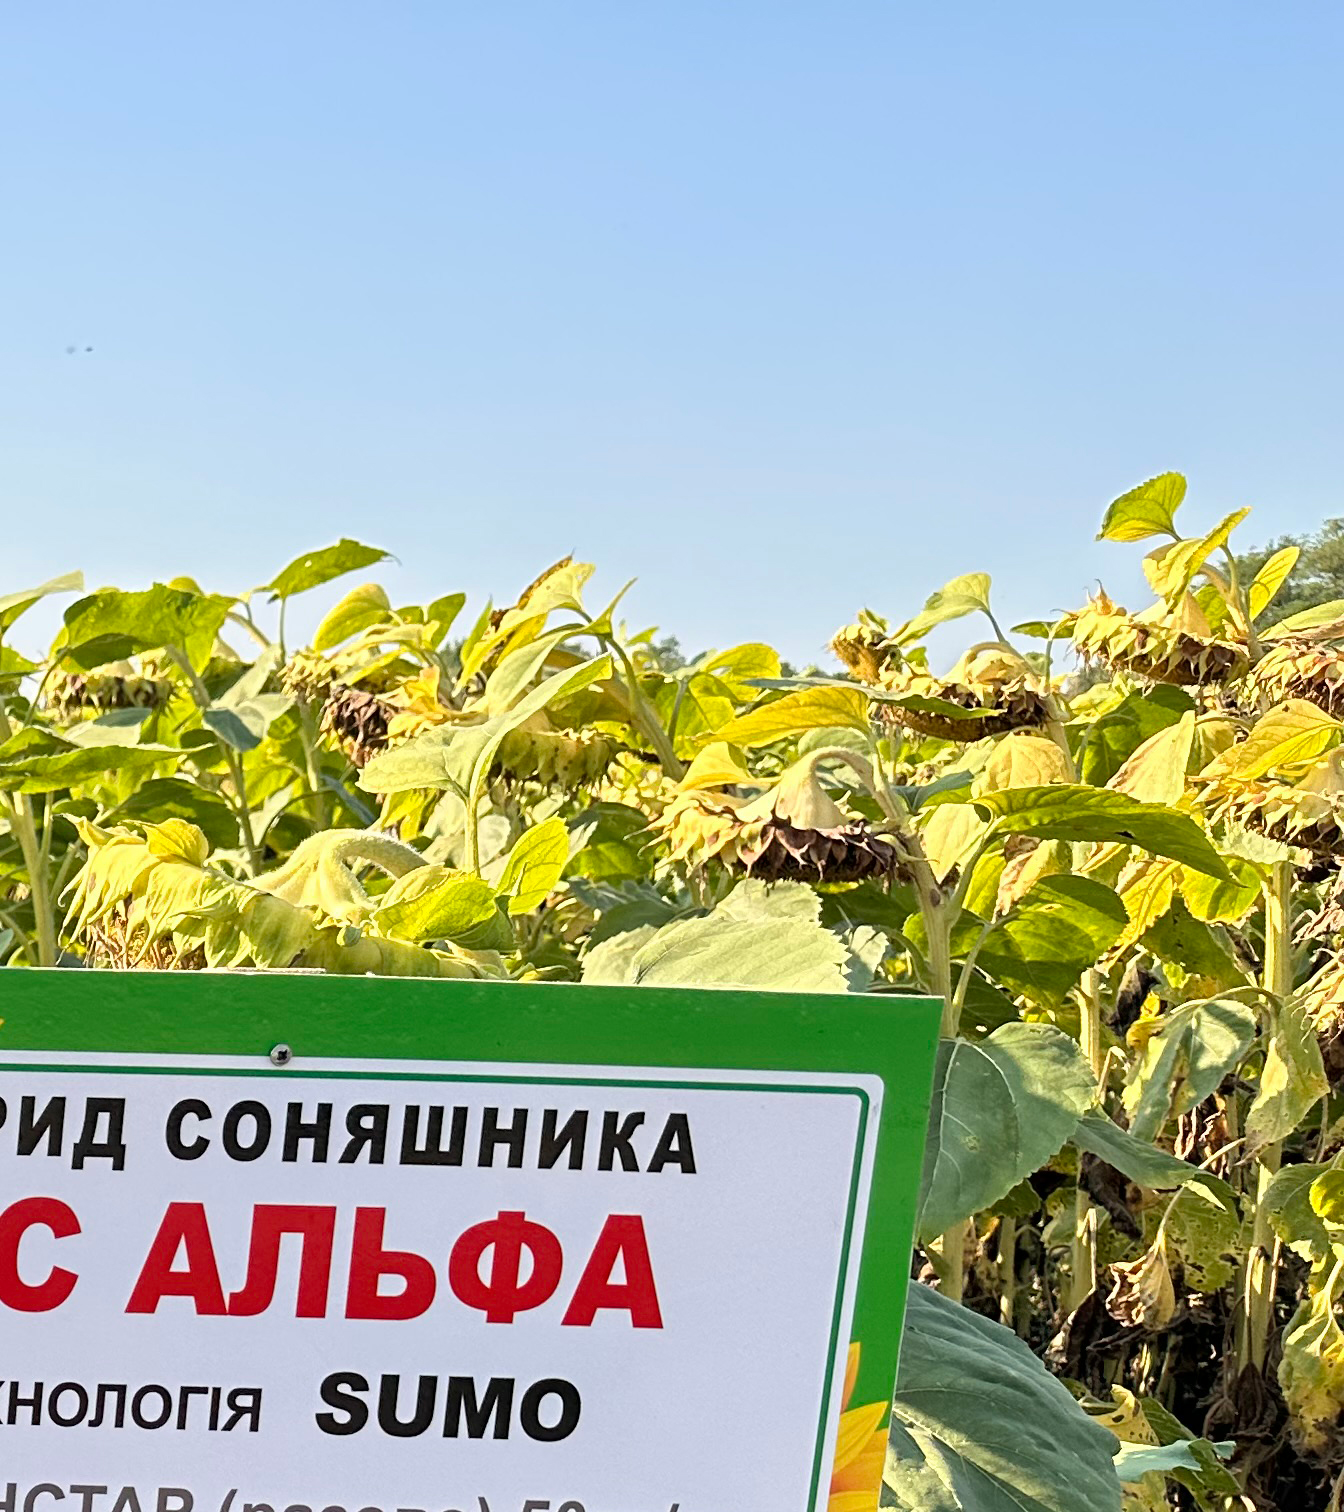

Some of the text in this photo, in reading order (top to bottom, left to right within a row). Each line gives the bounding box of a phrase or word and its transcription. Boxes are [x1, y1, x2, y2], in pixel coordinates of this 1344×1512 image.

[165, 1099, 700, 1175] СОНЯШНИКА
[126, 1202, 662, 1328] АЛЬФА
[315, 1372, 581, 1442] SUMO
